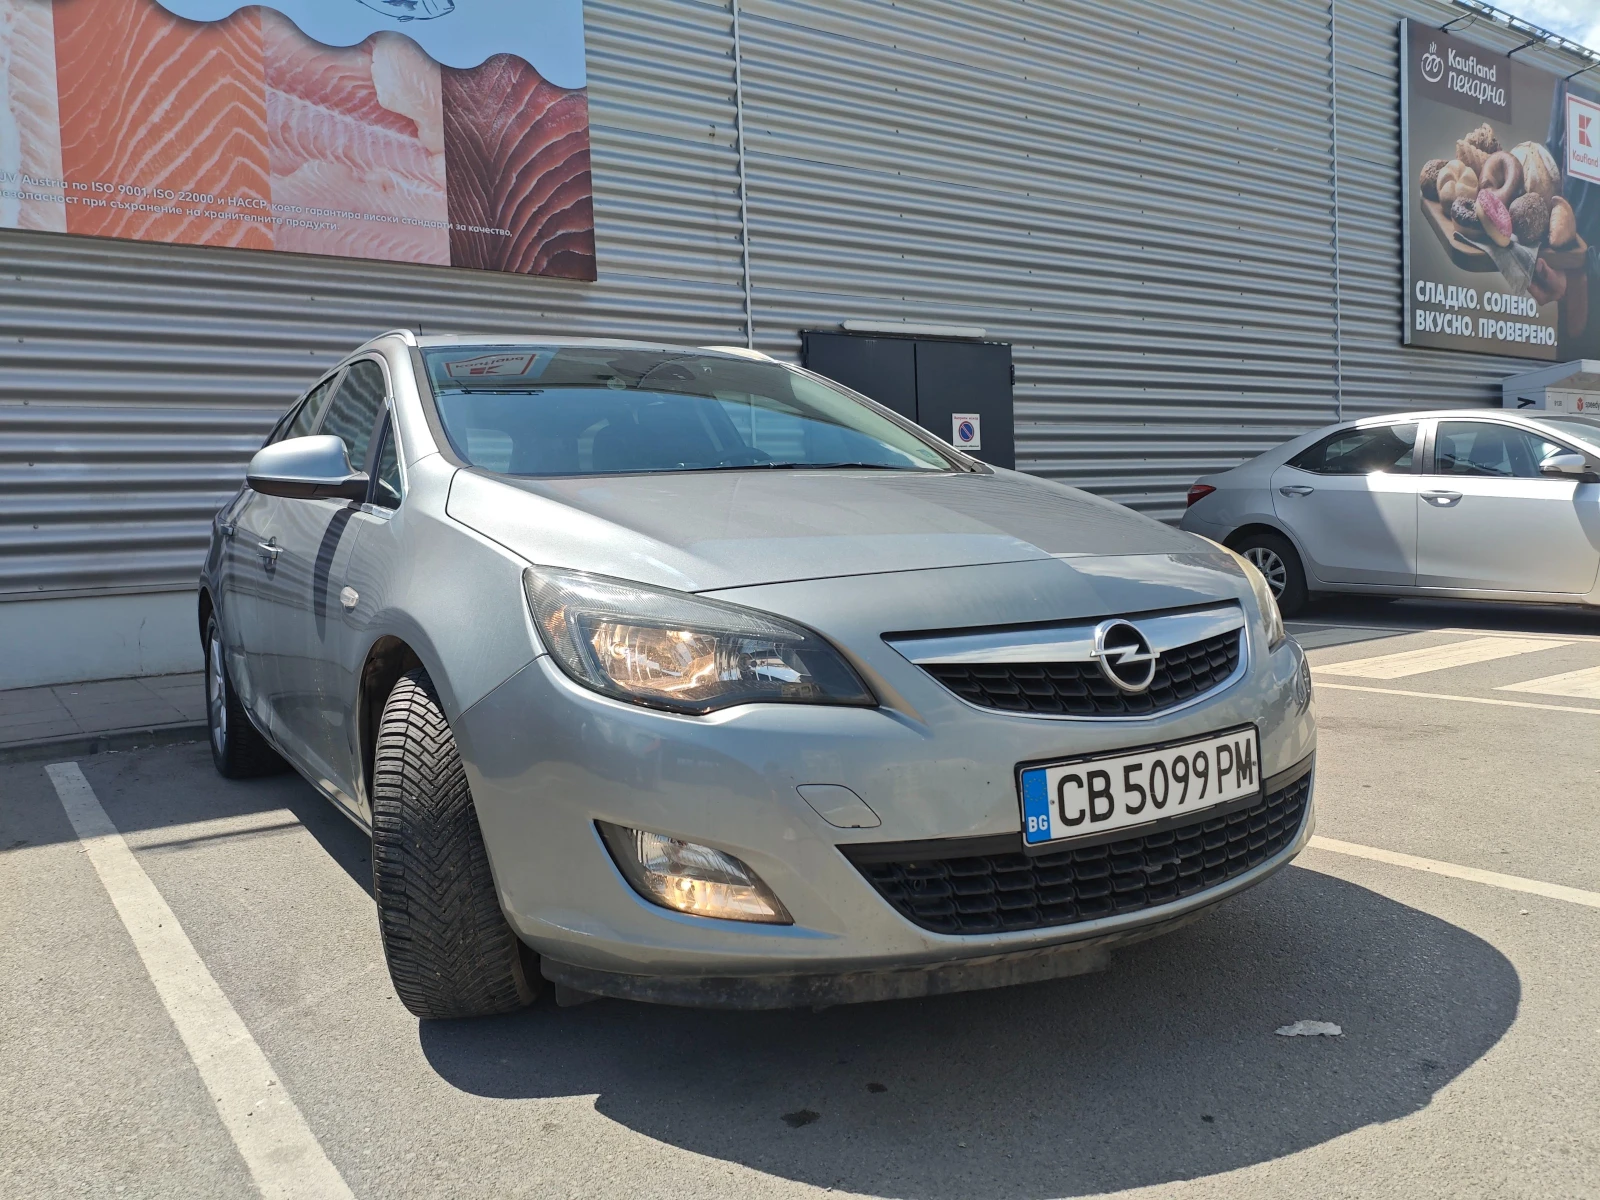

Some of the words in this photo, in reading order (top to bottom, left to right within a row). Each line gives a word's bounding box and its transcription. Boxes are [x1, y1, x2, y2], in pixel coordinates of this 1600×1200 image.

[1448, 47, 1496, 83] Kaufland
[1447, 71, 1506, 107] пекарна
[1572, 149, 1599, 169] Kaufland
[0, 189, 79, 204] езопасност
[82, 197, 107, 208] при
[109, 201, 182, 215] съхранение
[186, 207, 201, 217] на
[203, 211, 283, 225] хранителните
[286, 217, 340, 231] продукти.
[22, 174, 68, 189] Austria
[72, 182, 88, 191] по
[91, 182, 115, 193] ISO
[117, 184, 150, 199] 9001,
[153, 189, 175, 200] ISO
[179, 191, 214, 204] 22000
[271, 203, 302, 213] което
[305, 208, 361, 220] гарантира
[364, 214, 399, 223] високи
[401, 217, 453, 230] стандарти
[455, 223, 467, 231] за
[468, 225, 513, 238] качество,
[1415, 280, 1481, 311] СЛАДКО.
[1483, 291, 1540, 319] СОЛЕНО.
[1415, 309, 1475, 338] ВКУСНО.
[1478, 317, 1558, 347] ПРОВЕРЕНО.
[1027, 814, 1048, 833] BG
